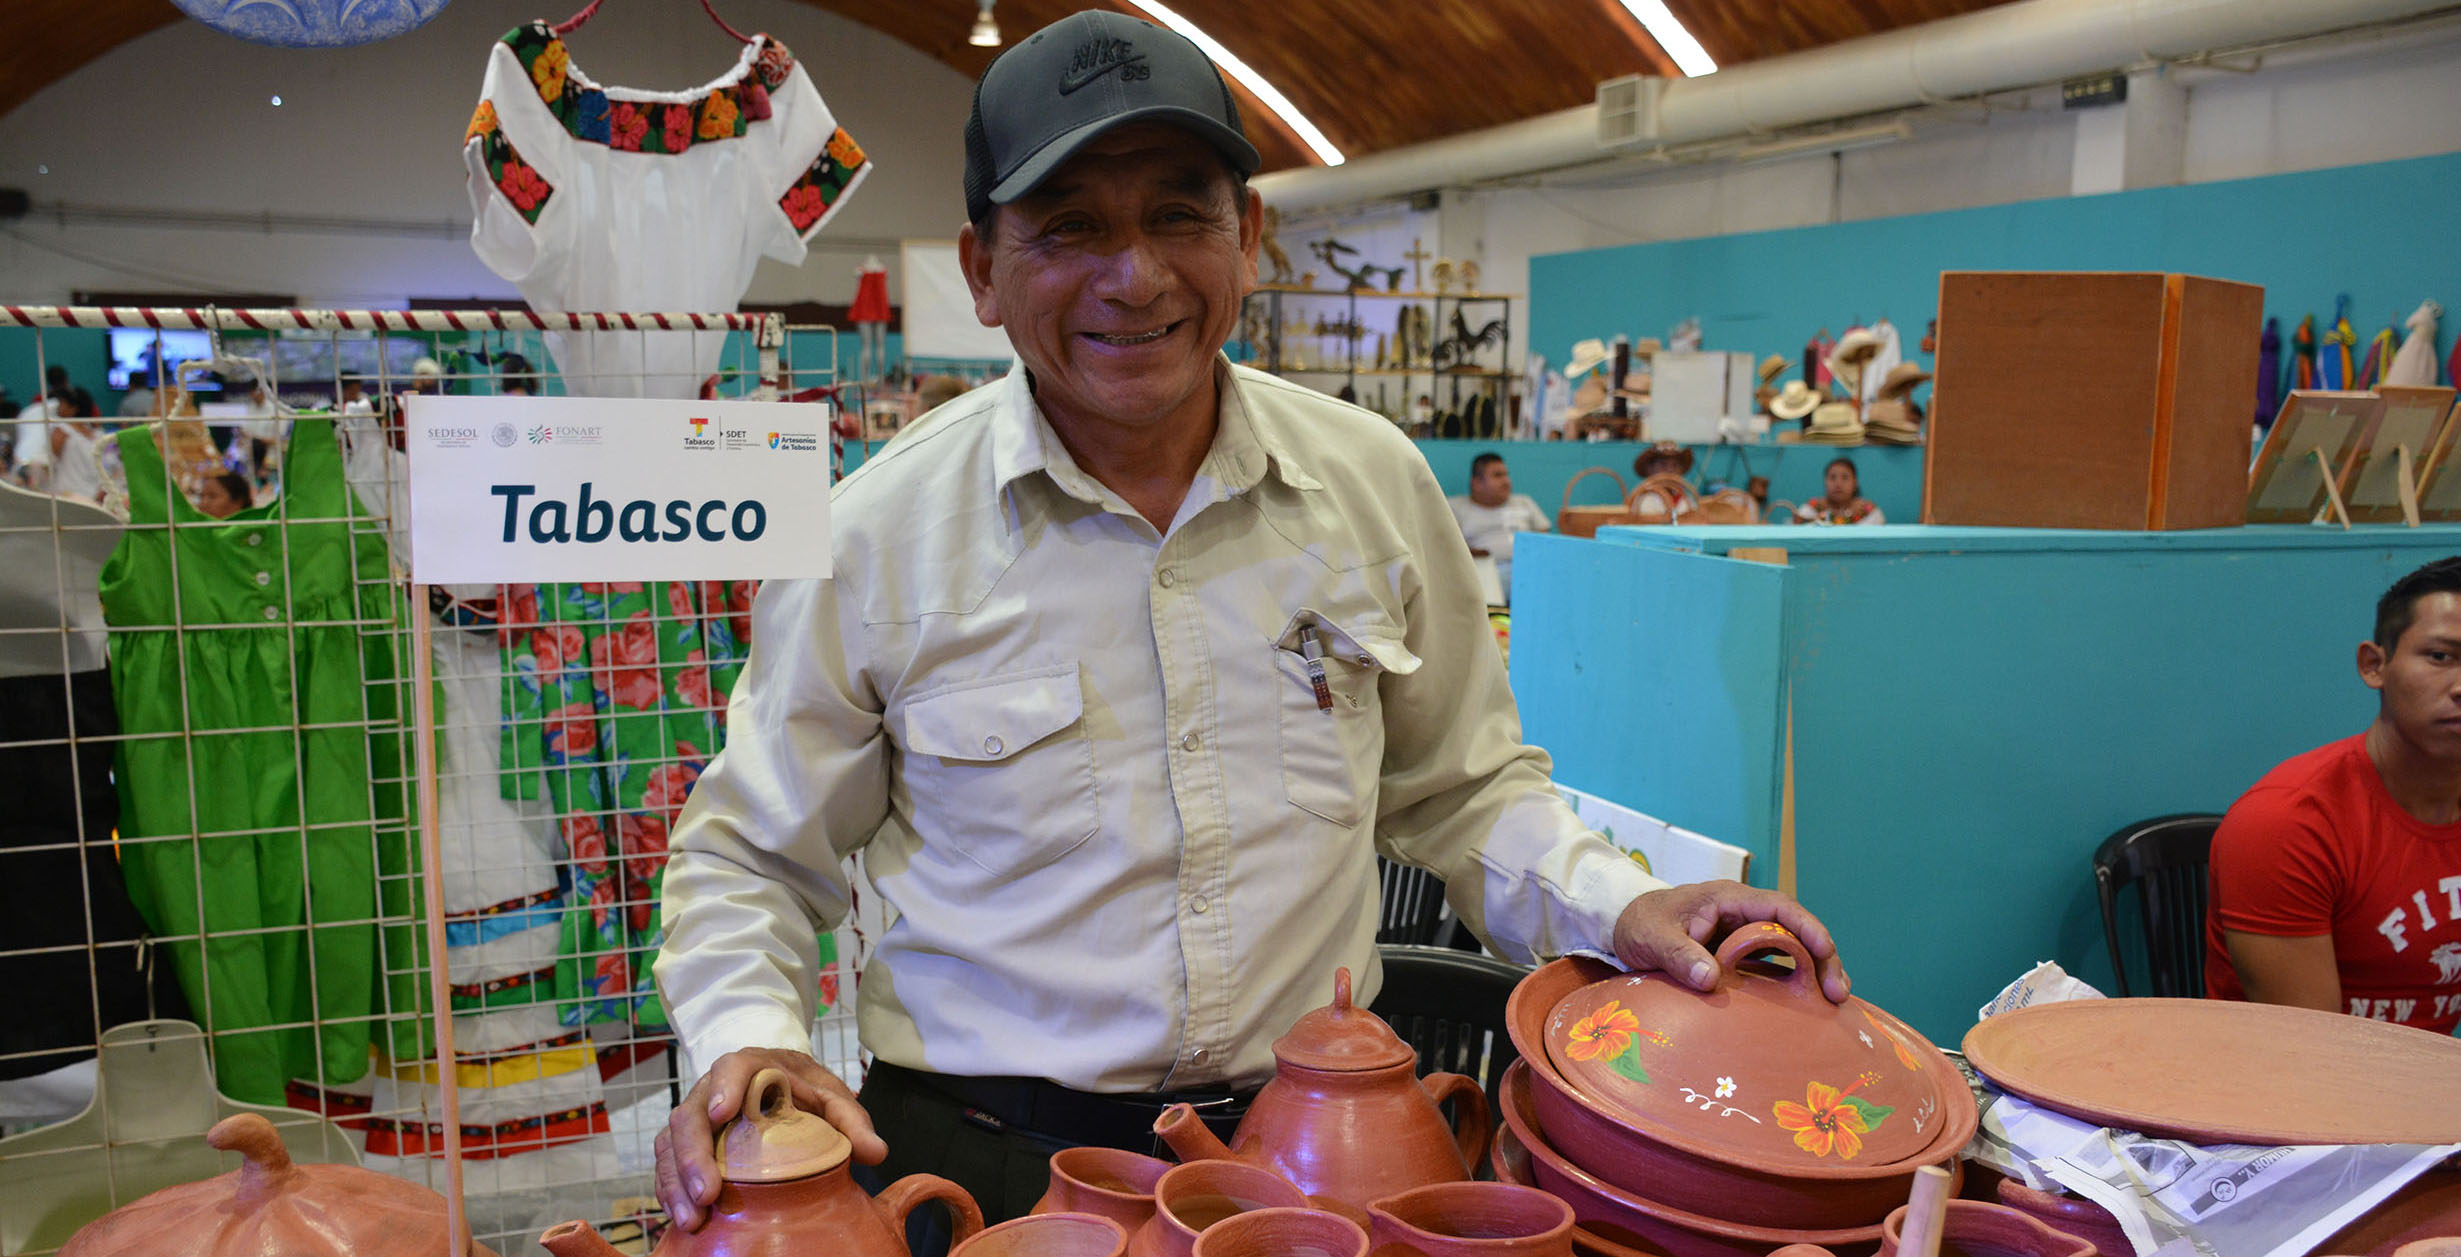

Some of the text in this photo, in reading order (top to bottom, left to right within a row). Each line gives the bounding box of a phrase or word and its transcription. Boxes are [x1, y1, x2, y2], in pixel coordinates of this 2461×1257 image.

[1071, 37, 1133, 73] NIKE
[427, 427, 479, 438] SEDESOL
[555, 426, 602, 437] FONART
[726, 430, 747, 439] SDET
[684, 438, 715, 446] Tabasco
[490, 481, 768, 544] Tabasco
[2350, 997, 2417, 1022] NEW
